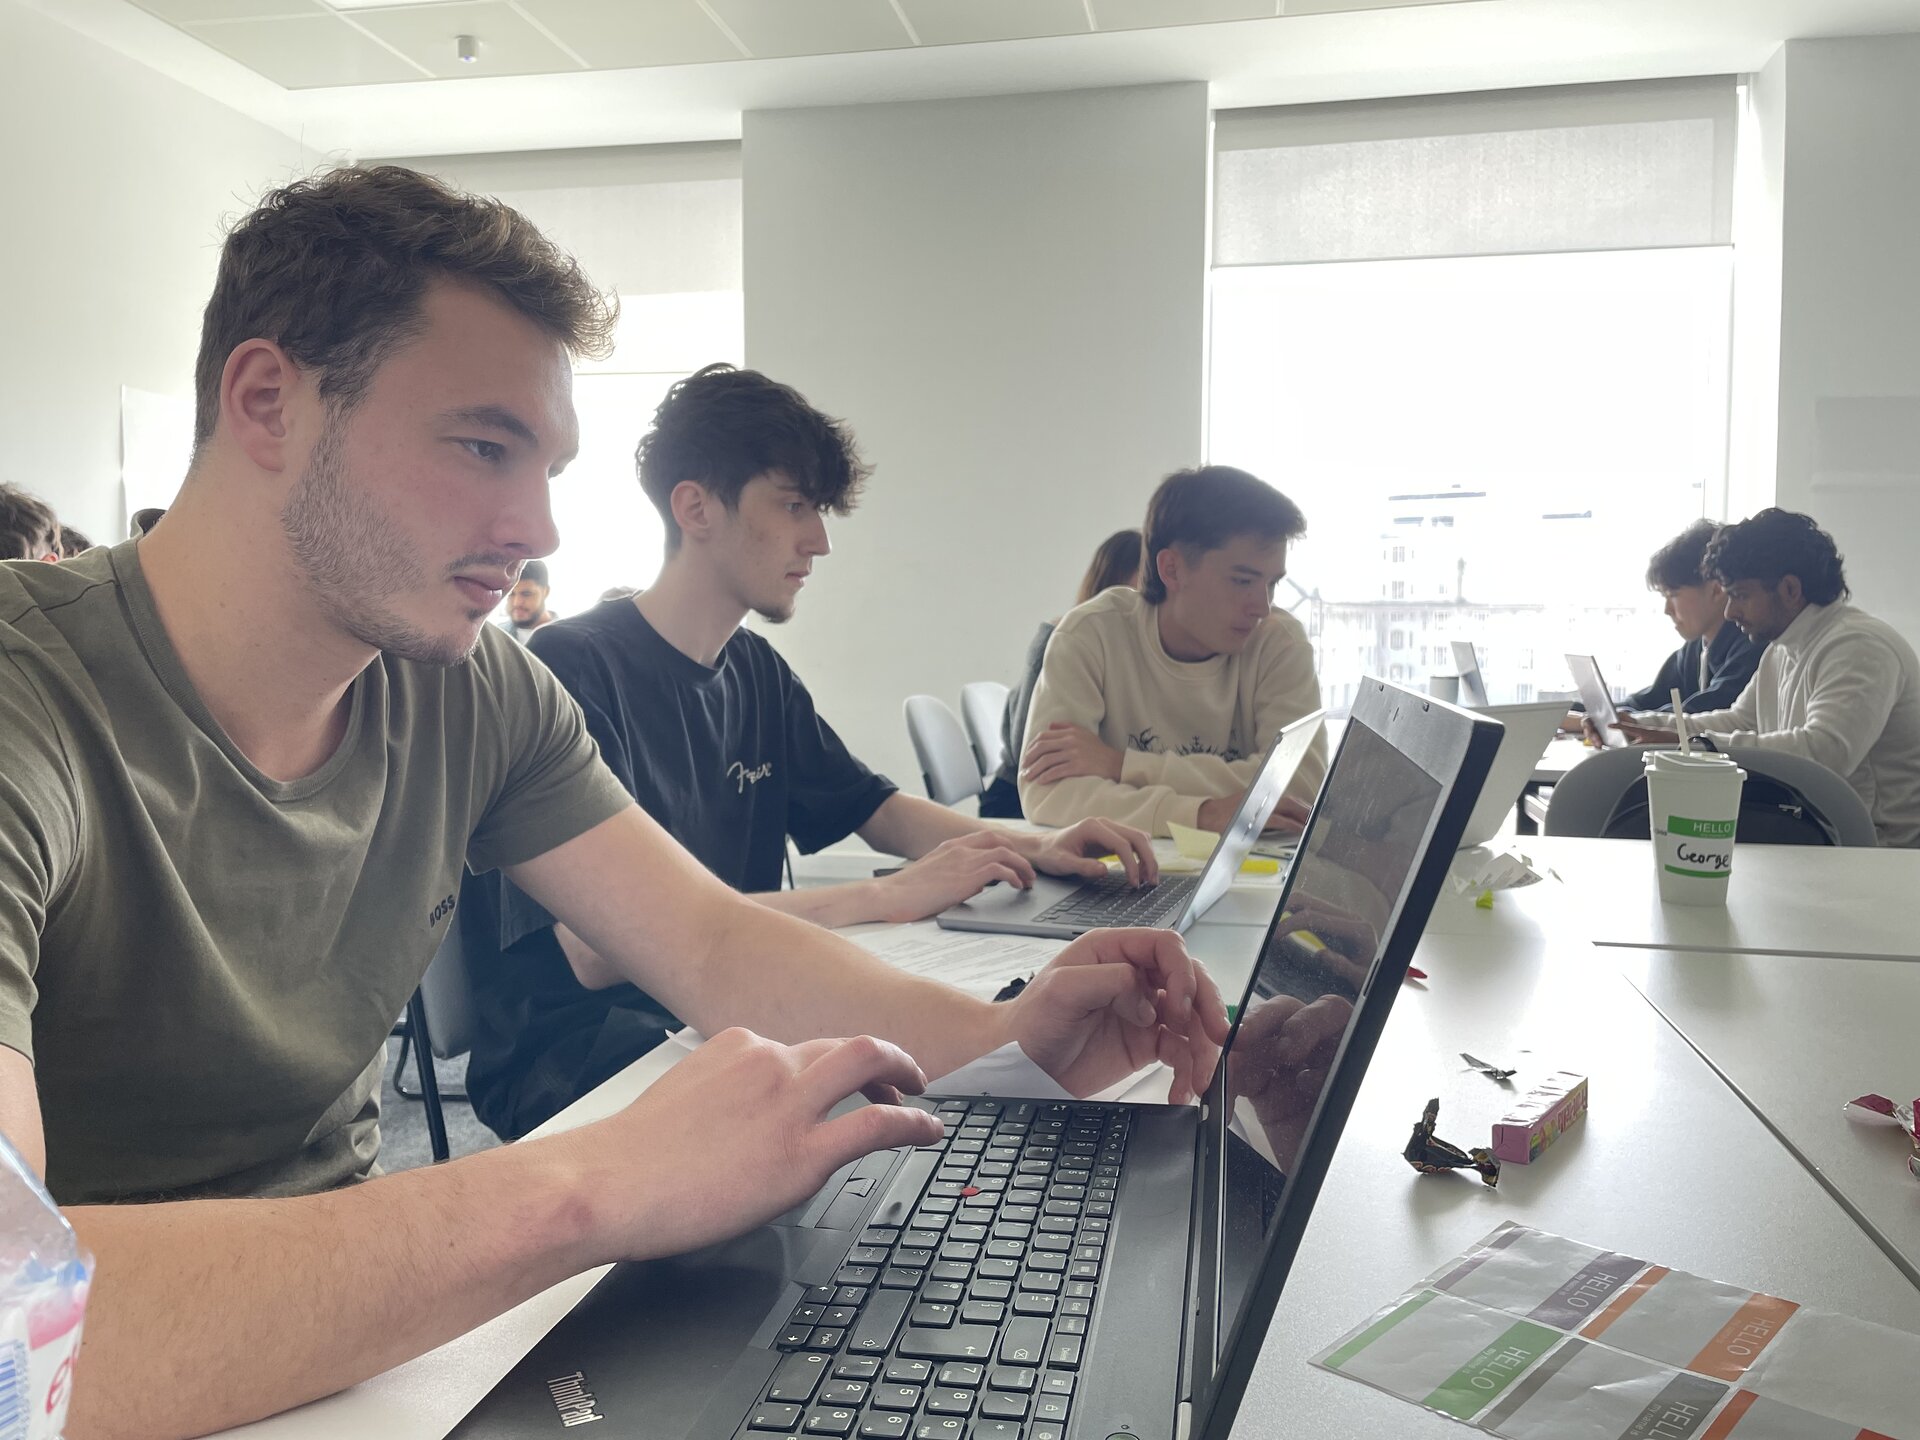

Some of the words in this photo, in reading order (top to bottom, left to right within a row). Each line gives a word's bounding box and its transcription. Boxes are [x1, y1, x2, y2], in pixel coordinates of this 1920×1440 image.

[1693, 822, 1731, 833] HELLO
[1676, 843, 1729, 870] George
[429, 894, 456, 928] BOSS
[1567, 1271, 1618, 1307] HELLO
[1727, 1316, 1776, 1356] HELLO
[1471, 1346, 1532, 1389] HELLO
[547, 1371, 603, 1427] ThinkPad
[1643, 1401, 1700, 1440] HELL
